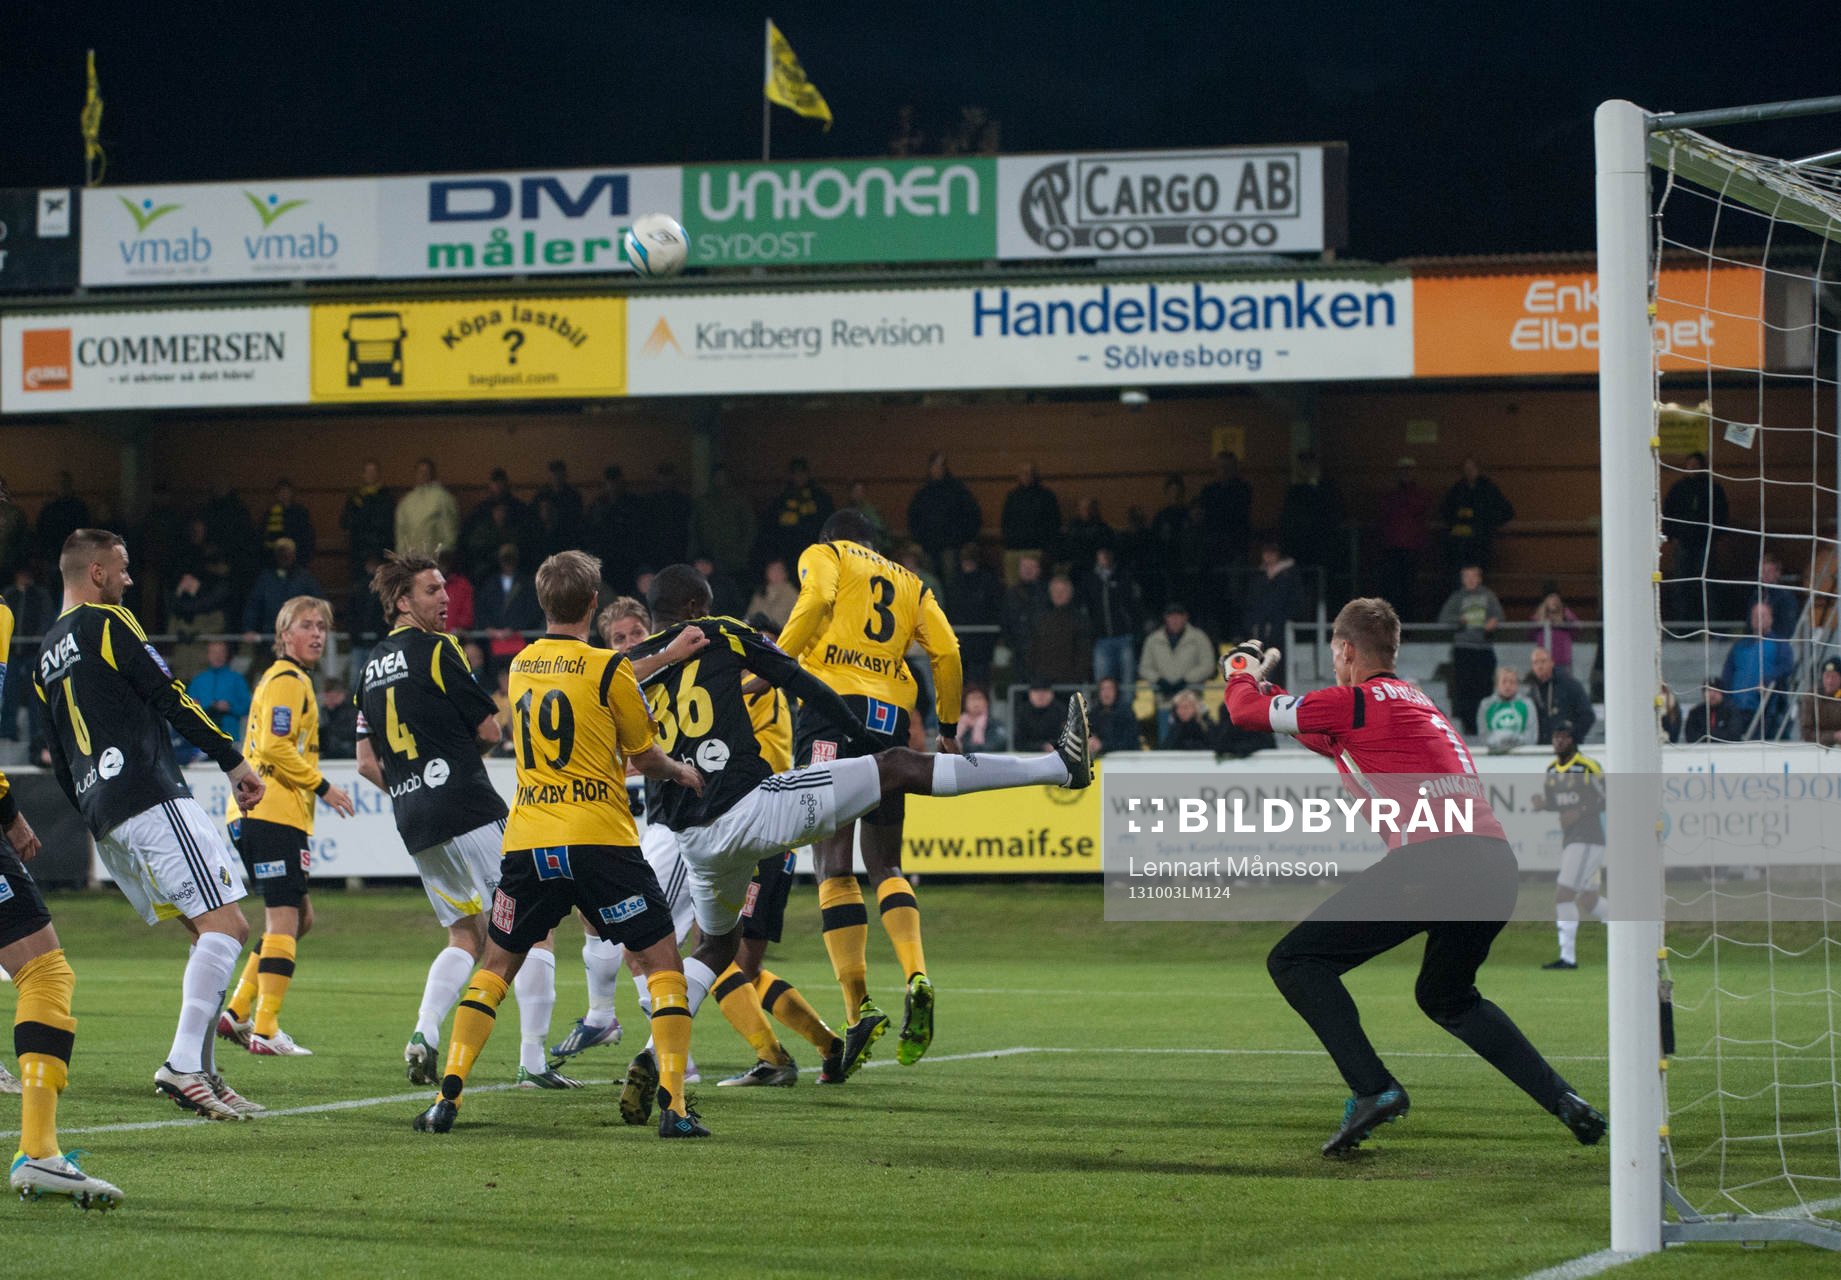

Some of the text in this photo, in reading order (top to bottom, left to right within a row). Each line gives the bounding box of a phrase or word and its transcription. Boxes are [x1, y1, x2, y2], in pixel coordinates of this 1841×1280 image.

[429, 174, 630, 222] DM
[699, 165, 979, 221] UNIONEN
[1085, 160, 1292, 216] CARGO AB
[120, 227, 212, 264] vmab
[244, 224, 339, 260] vmab
[700, 232, 816, 261] SYDOST
[973, 281, 1395, 337] Handelsbanken
[1524, 280, 1599, 312] Enk
[441, 304, 588, 349] Köpa lastbil
[696, 317, 944, 356] Kindberg Revision
[77, 332, 286, 367] COMMERSEN
[503, 329, 525, 365] ?
[1104, 344, 1262, 370] Sölvesborg
[864, 575, 895, 643] 3
[41, 633, 79, 679] SVEA
[365, 650, 408, 684] SVEA
[553, 656, 586, 675] Rock
[824, 644, 891, 675] RINKABY
[386, 686, 419, 760] 4
[645, 659, 714, 754] 36
[515, 688, 575, 770] 19
[572, 778, 608, 802] RÖR
[1664, 761, 1841, 802] sölvesbo
[902, 828, 1094, 858] ww.maif.se
[1680, 804, 1790, 847] energi
[601, 898, 644, 919] BLT.se
